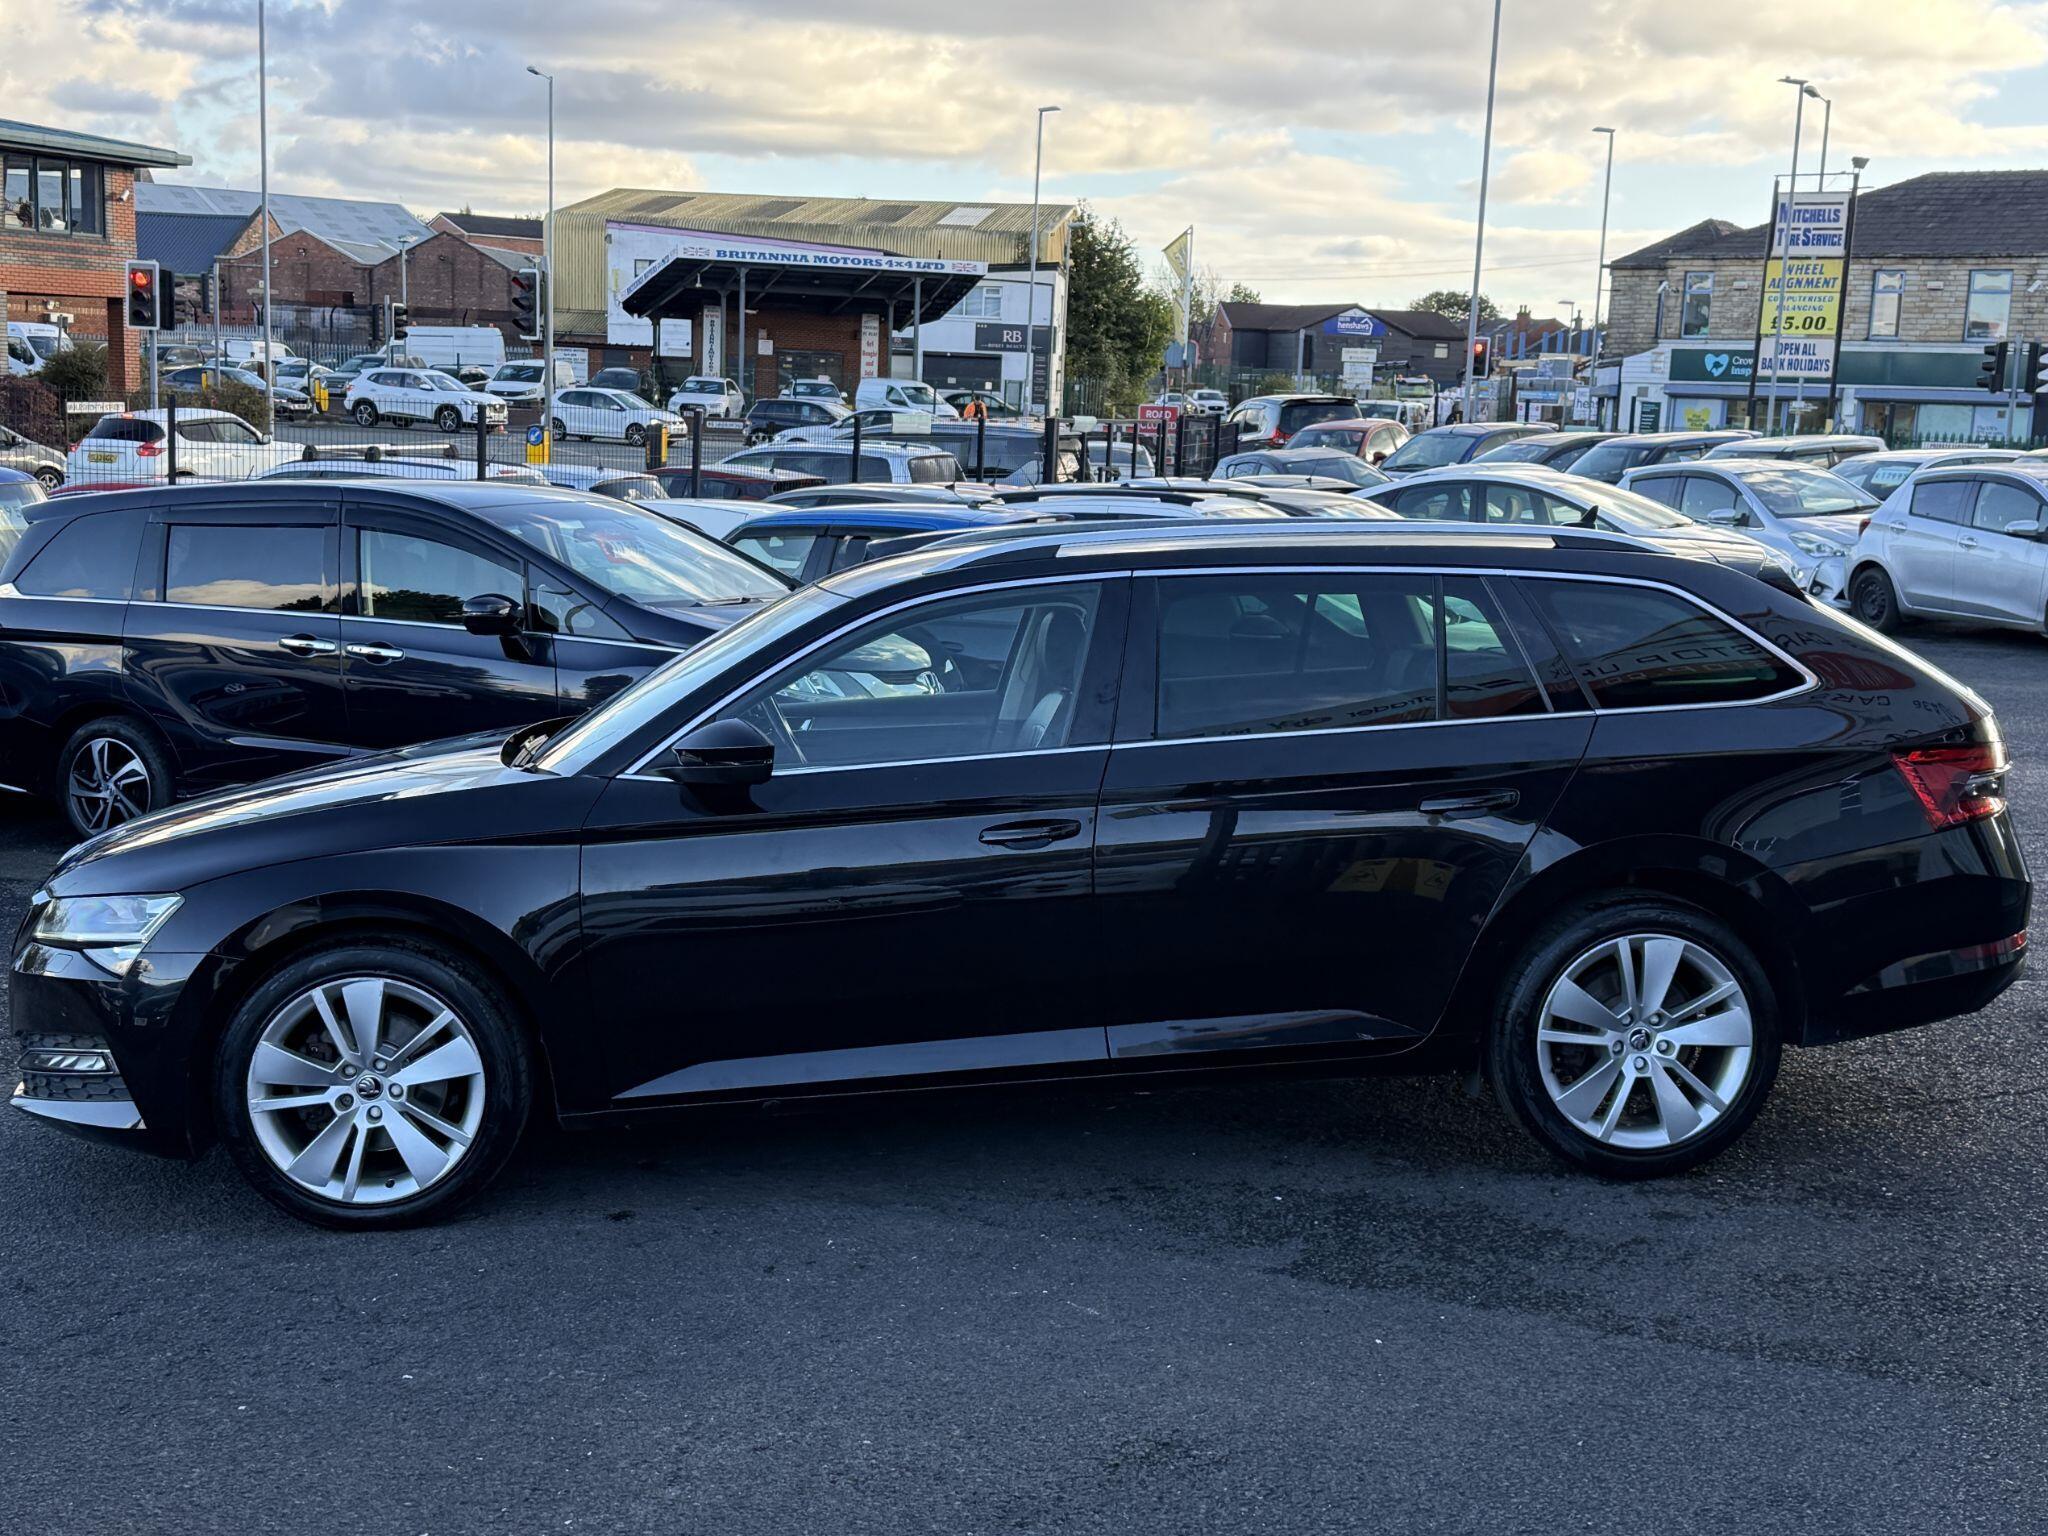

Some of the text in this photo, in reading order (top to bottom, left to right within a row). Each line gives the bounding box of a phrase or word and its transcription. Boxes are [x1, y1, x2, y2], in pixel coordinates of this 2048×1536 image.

[1777, 227, 1843, 247] TRE SERVICE
[716, 249, 945, 271] BRITANNIA MOTORS 4x4 LTD
[1768, 276, 1838, 289] ALGNMENT
[1770, 315, 1827, 331] £5.00
[1002, 330, 1023, 343] RB
[1802, 343, 1817, 356] ALL
[1761, 357, 1831, 373] BAK HOLIDAYS
[1145, 409, 1172, 419] ROAD
